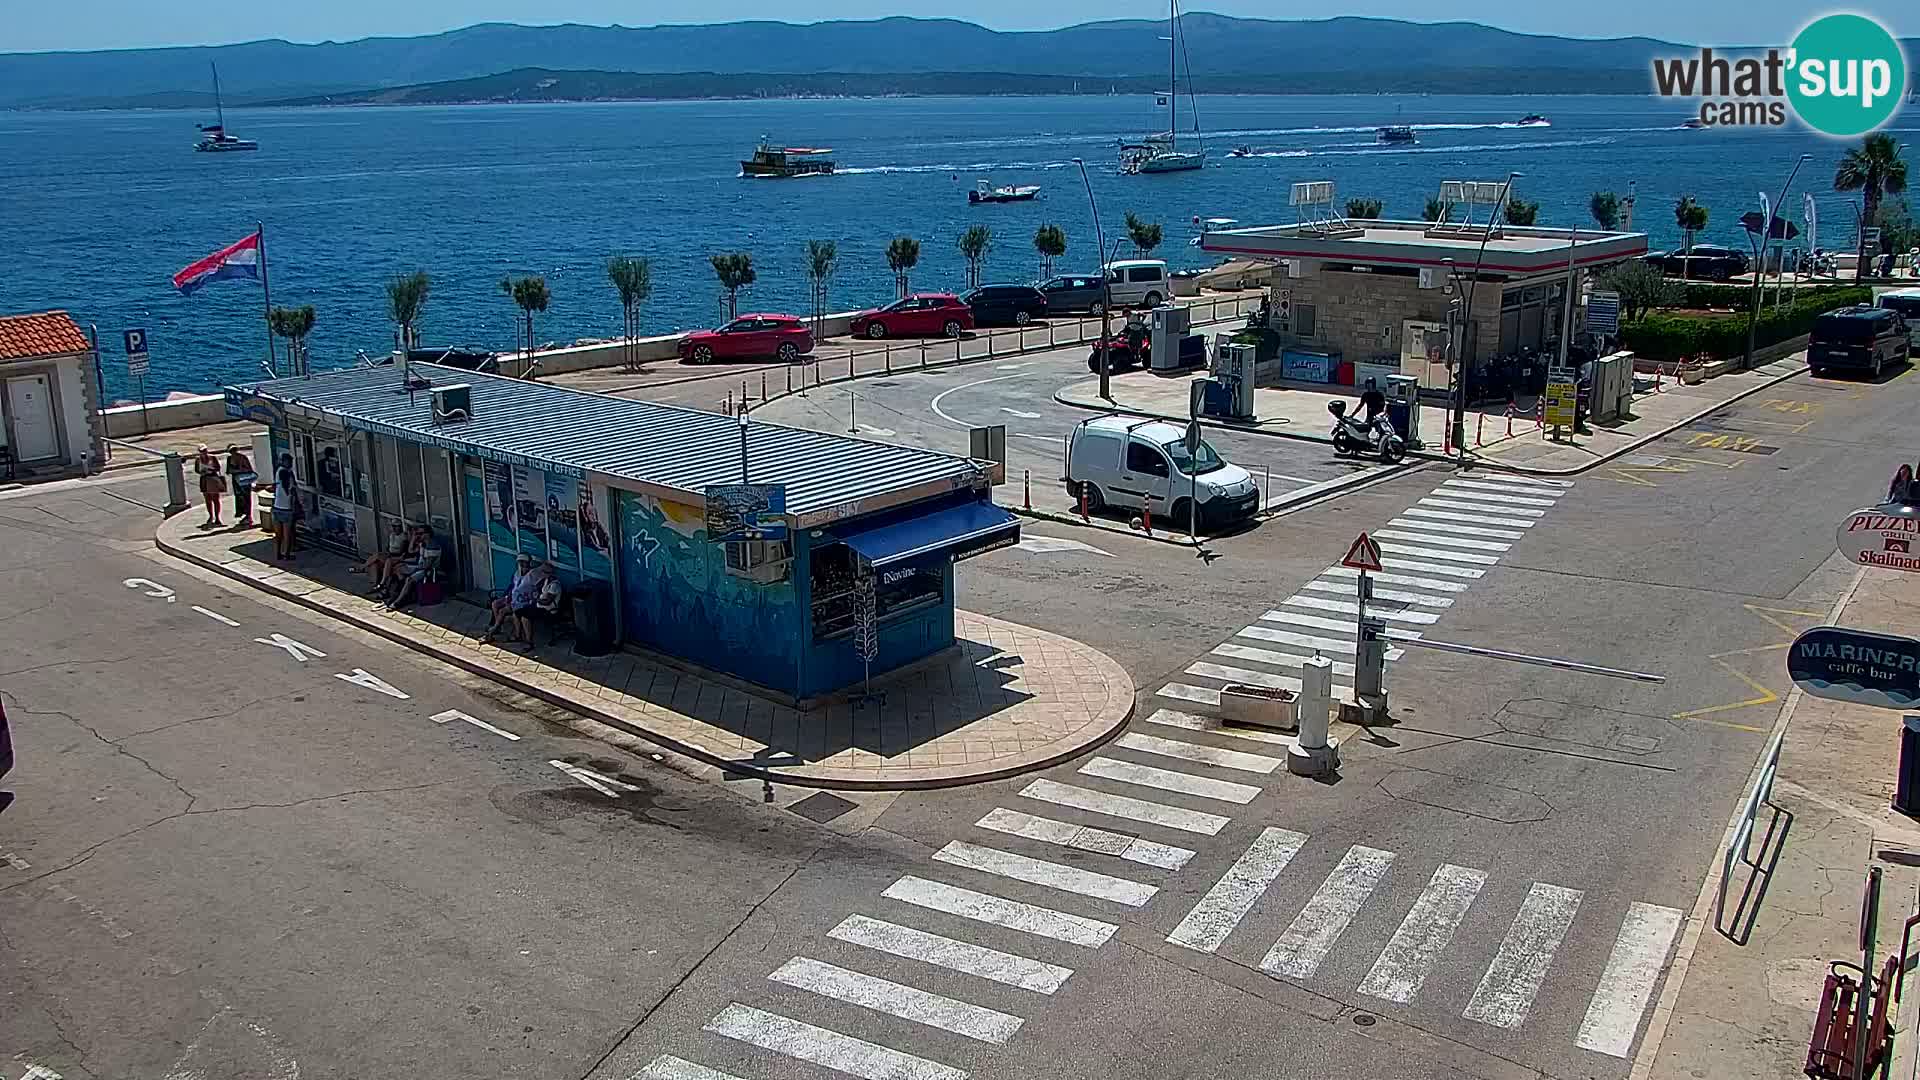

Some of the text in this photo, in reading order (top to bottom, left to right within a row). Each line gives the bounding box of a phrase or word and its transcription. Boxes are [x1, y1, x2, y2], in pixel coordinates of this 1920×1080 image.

[129, 332, 142, 351] P
[494, 452, 526, 466] STATION
[527, 458, 553, 473] TICKET
[554, 464, 582, 479] OFFICE
[1881, 531, 1917, 541] GRILL
[1870, 666, 1897, 681] bar
